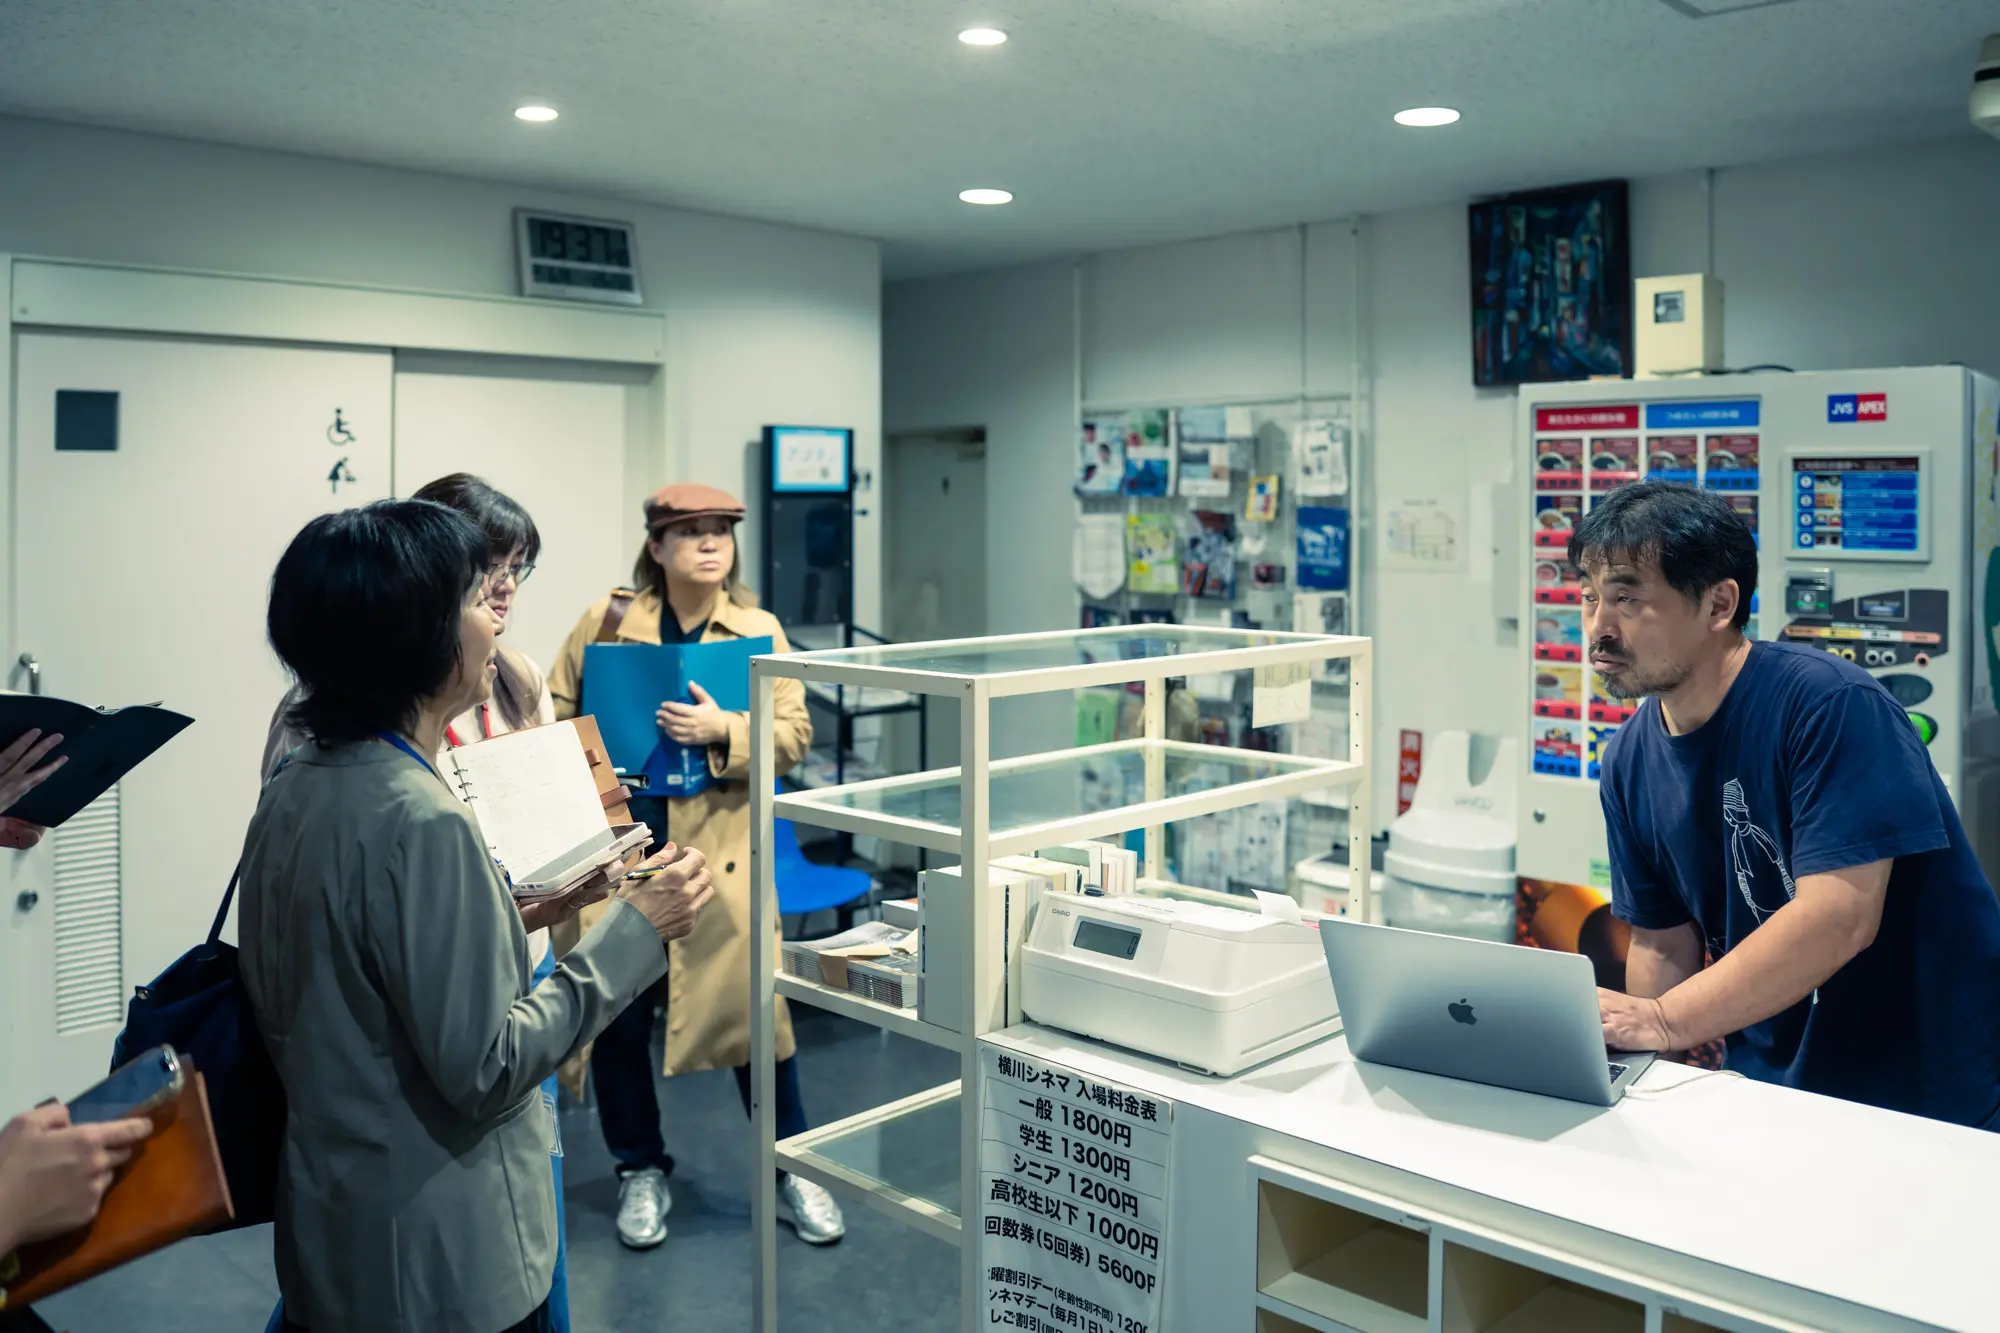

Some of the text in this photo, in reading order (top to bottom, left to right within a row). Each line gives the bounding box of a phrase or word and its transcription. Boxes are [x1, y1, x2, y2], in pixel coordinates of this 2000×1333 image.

[1831, 401, 1885, 415] JVS APEX
[1051, 908, 1071, 917] CASIO
[997, 1054, 1157, 1123] 横川シネマ 入場料金表
[1018, 1097, 1131, 1148] 一般 1800円
[1019, 1123, 1131, 1182] 学生 1300円
[1013, 1153, 1139, 1218] シニア 1200円
[985, 1215, 1090, 1267] 回数券(5回券)
[991, 1178, 1158, 1260] 高校生以下 1000円
[988, 1266, 1113, 1323] 曜割引デー(年齢性別不問)
